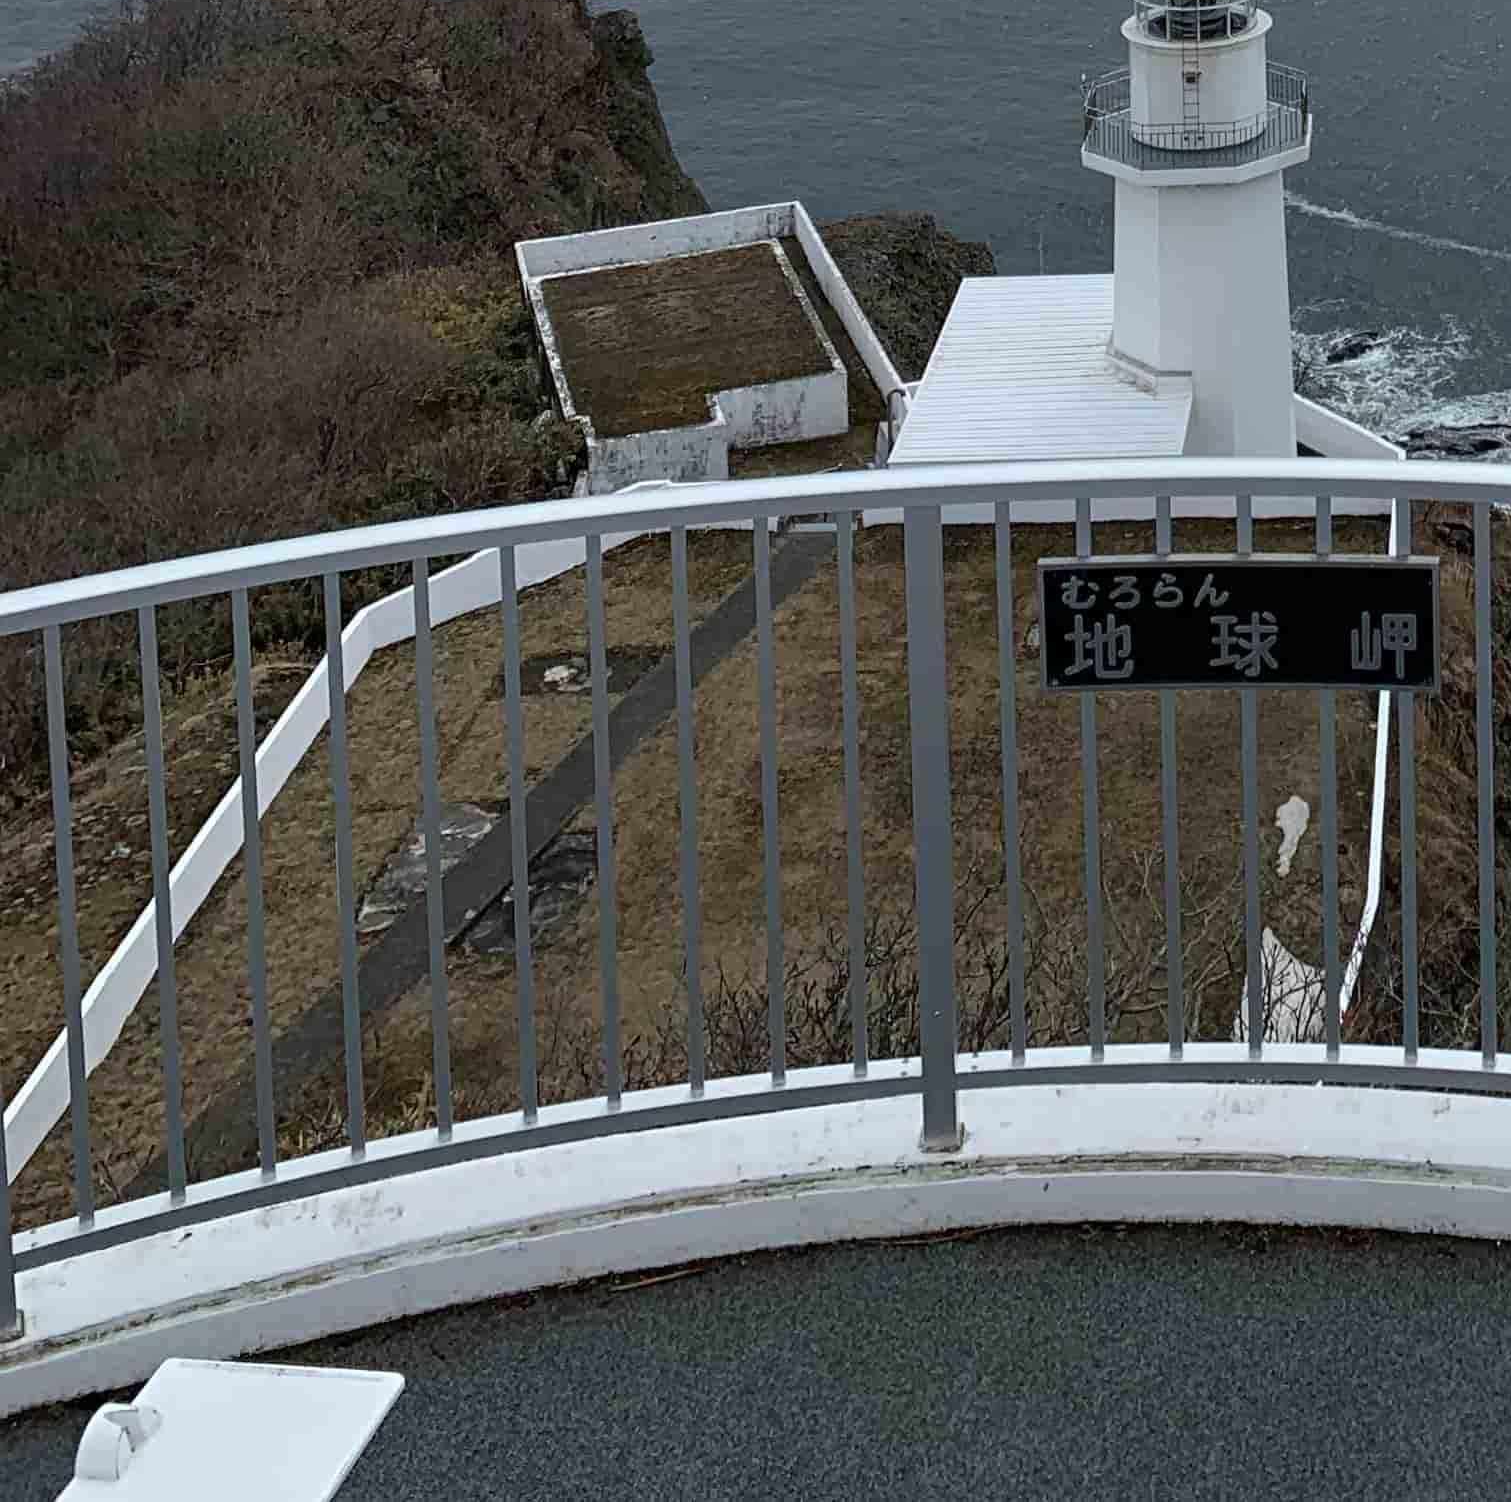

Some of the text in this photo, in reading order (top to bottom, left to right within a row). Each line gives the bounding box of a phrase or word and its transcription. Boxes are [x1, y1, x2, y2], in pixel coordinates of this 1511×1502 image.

[1061, 573, 1230, 610] むろらん
[1064, 610, 1417, 679] 地球岬
